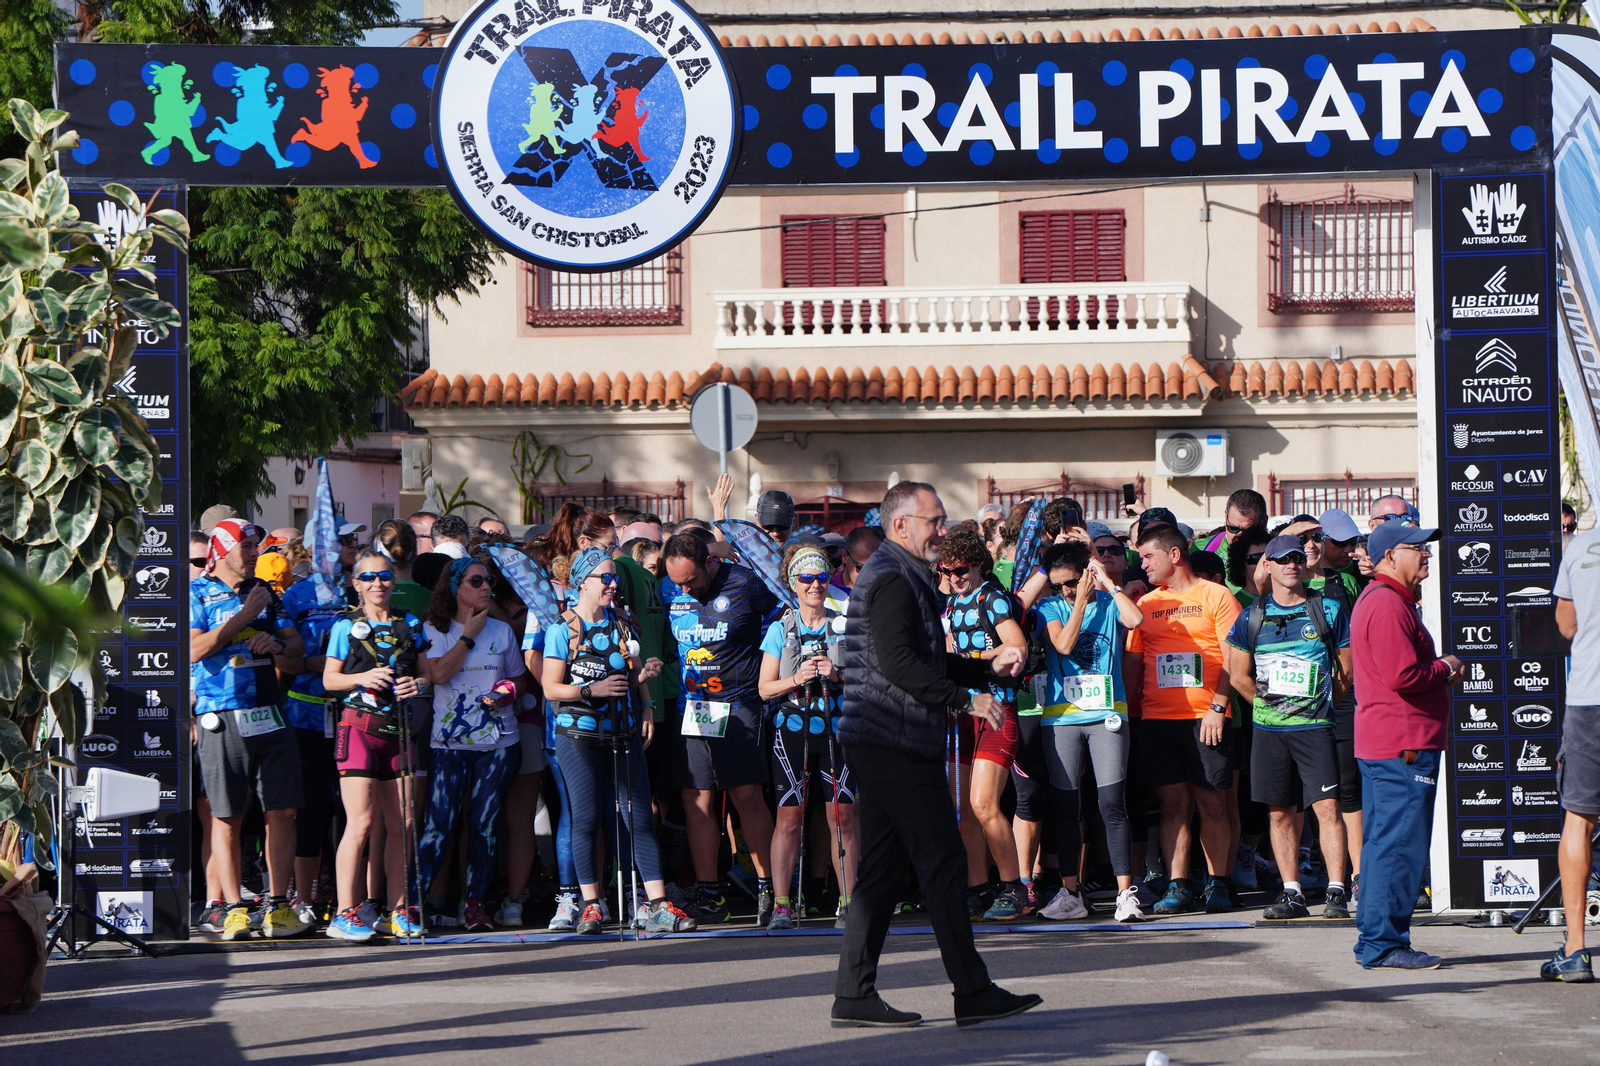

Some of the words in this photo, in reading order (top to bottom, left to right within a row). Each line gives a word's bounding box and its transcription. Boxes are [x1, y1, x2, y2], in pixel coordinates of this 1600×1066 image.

[463, 0, 575, 65] TRAIL
[811, 71, 1103, 153] TRAIL
[1139, 58, 1492, 148] PIRATA
[673, 134, 716, 205] 2023
[457, 121, 494, 199] SIERRA
[490, 194, 531, 230] SAN
[531, 222, 648, 248] CRISTOBAL
[1461, 236, 1500, 245] AUTISMO
[1501, 234, 1527, 244] CÁDIZ
[1452, 293, 1539, 308] LIBERTIUM
[1455, 307, 1536, 317] AUTOCARAVANAS
[1462, 387, 1532, 403] INAUTO
[1514, 469, 1548, 483] CAV
[1451, 481, 1494, 490] RECOSUR
[1151, 610, 1165, 619] TOP
[1166, 604, 1203, 616] RUNNERS
[1462, 626, 1492, 643] TC
[138, 652, 169, 669] TC
[586, 661, 606, 671] TRAIL
[570, 664, 608, 678] PIRATA
[1161, 664, 1190, 676] 1432
[1276, 670, 1304, 684] 1425
[1463, 679, 1494, 690] BAMBÚ
[1514, 676, 1549, 691] alpha
[1070, 686, 1100, 698] 1130
[138, 706, 169, 717] BAMBÚ
[242, 710, 271, 724] 1022
[1516, 713, 1551, 723] LUGO
[82, 743, 117, 752] LUGO
[1494, 885, 1535, 895] PIRATA
